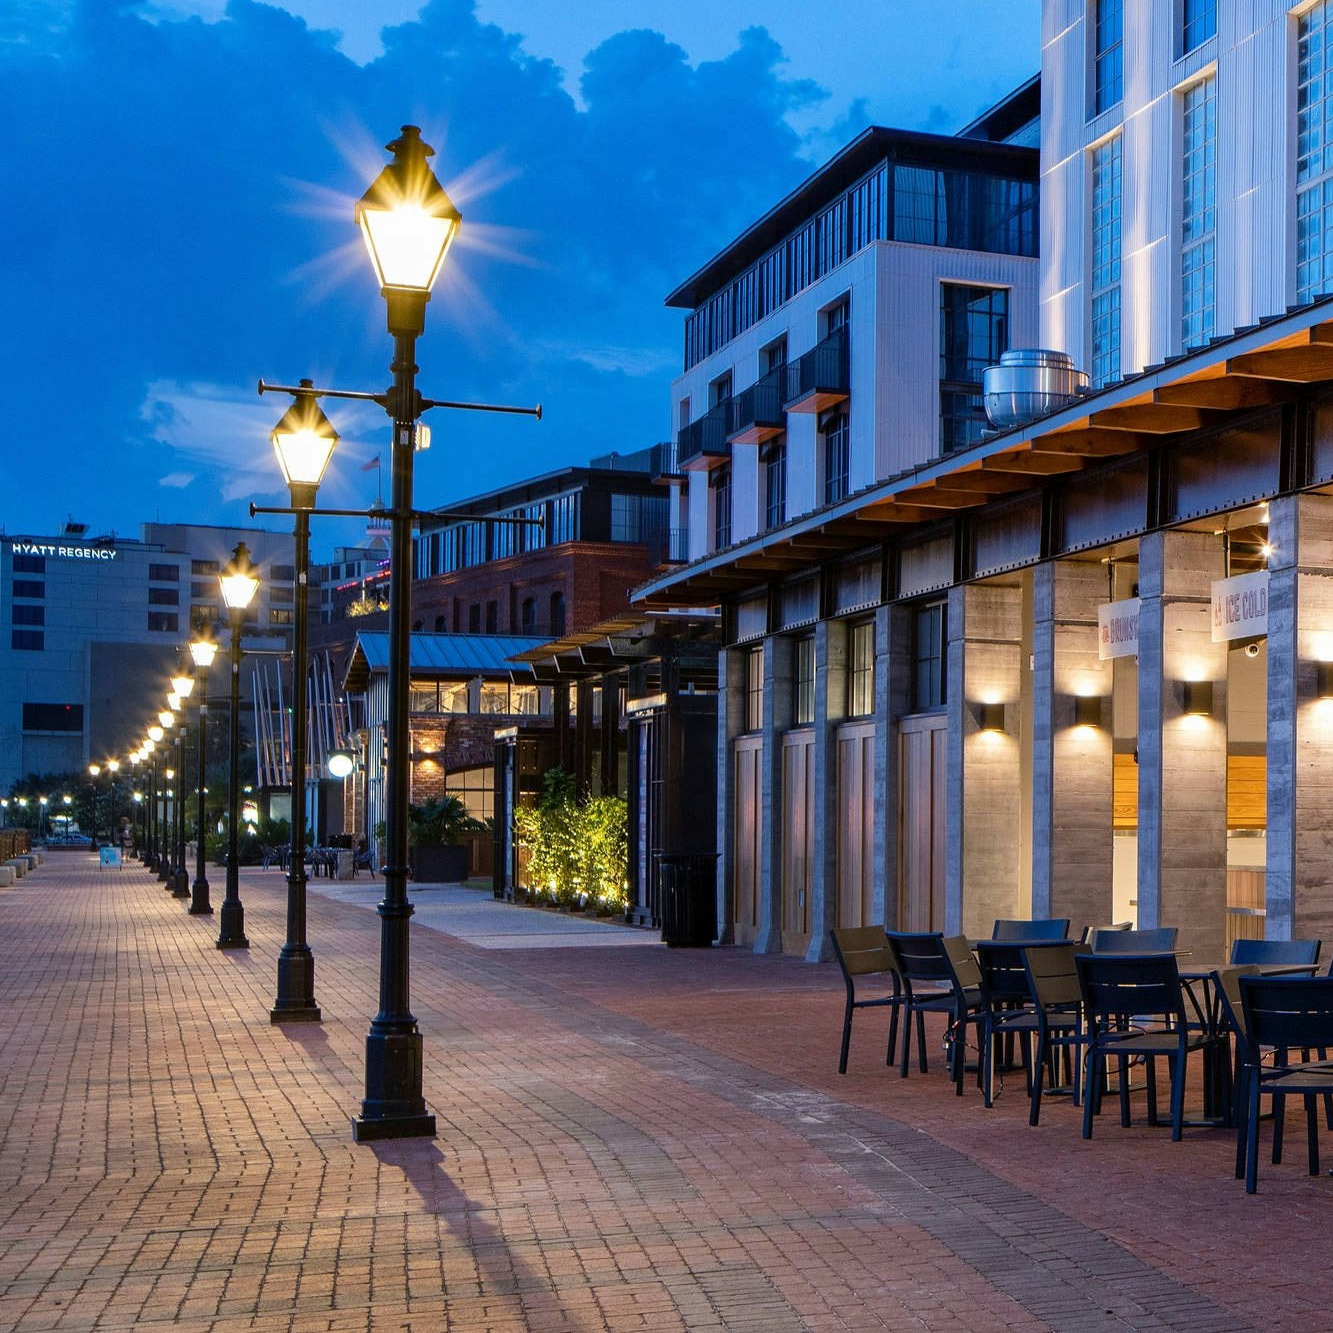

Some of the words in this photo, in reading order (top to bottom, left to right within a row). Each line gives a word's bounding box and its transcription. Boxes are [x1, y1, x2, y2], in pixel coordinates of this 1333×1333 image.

[12, 544, 55, 556] HYATT
[58, 547, 116, 559] REGENCY
[1226, 594, 1240, 624] ICE
[1243, 588, 1266, 620] COLD
